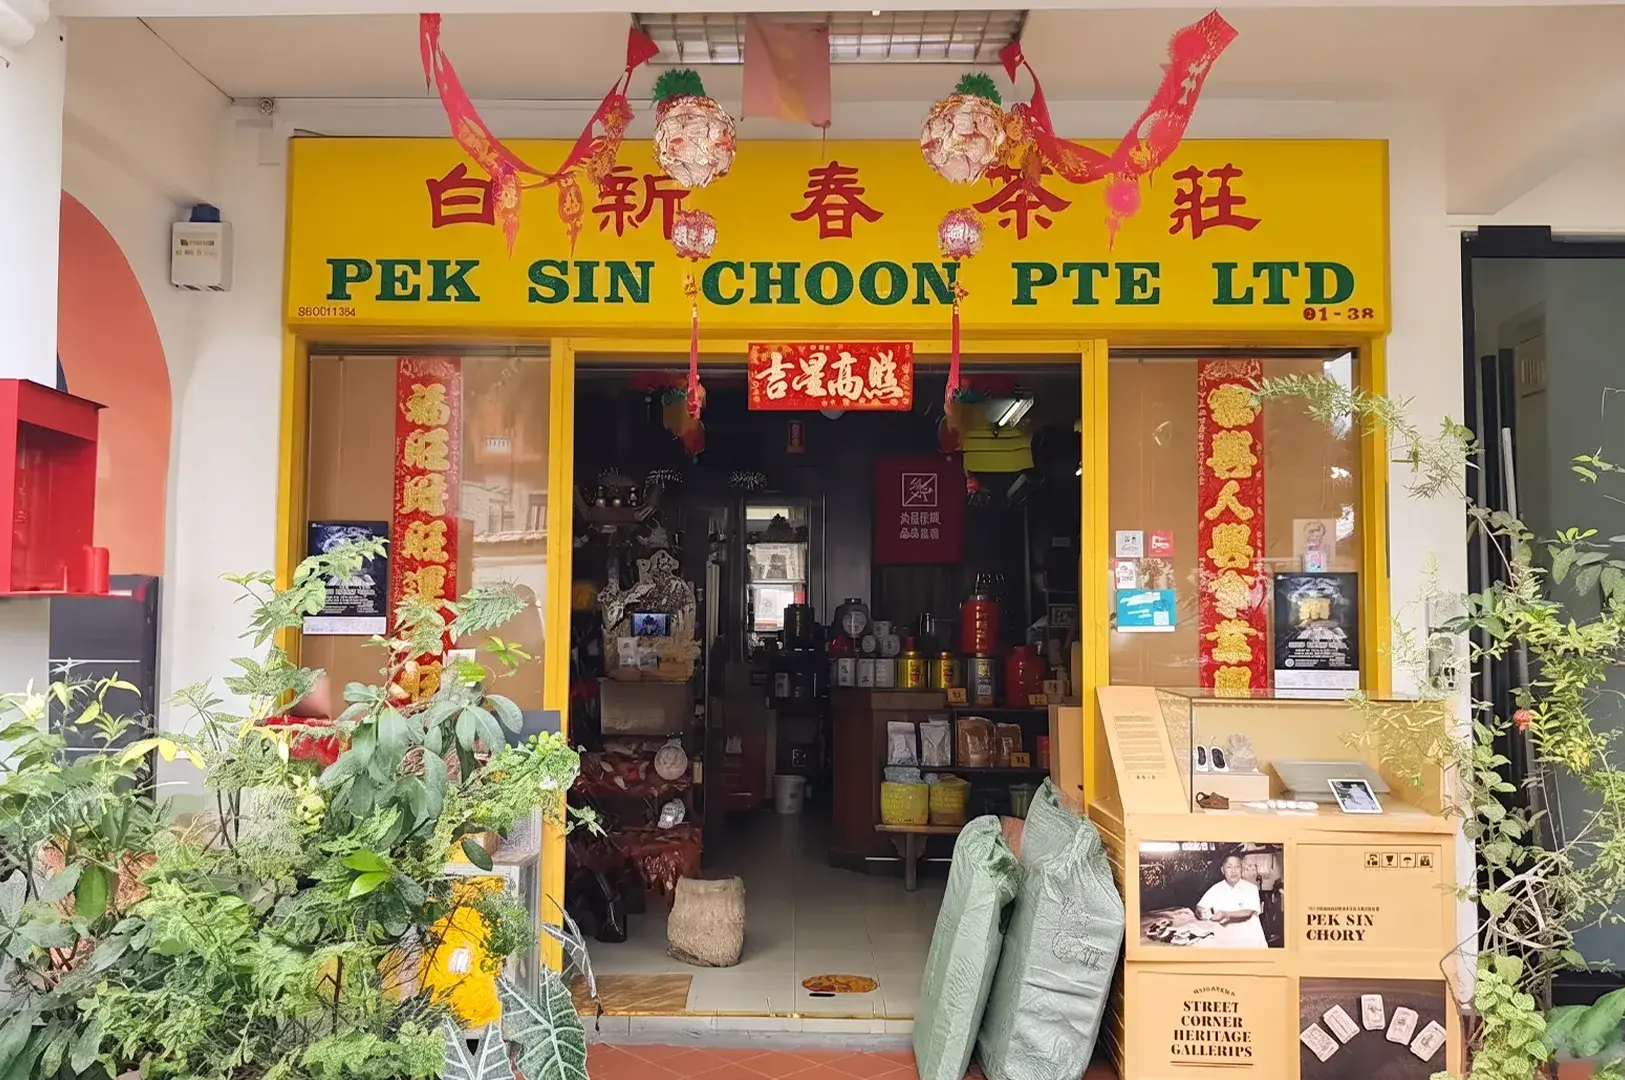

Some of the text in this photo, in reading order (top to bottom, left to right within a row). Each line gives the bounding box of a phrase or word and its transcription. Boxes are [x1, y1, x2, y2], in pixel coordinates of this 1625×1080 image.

[327, 258, 1355, 305] PEK SIN CHOON PTE LTD
[1306, 913, 1375, 927] PEK SIN
[1183, 1000, 1239, 1013] STREET
[1181, 1015, 1243, 1028] CORNER
[1174, 1029, 1252, 1043] HERITAGE
